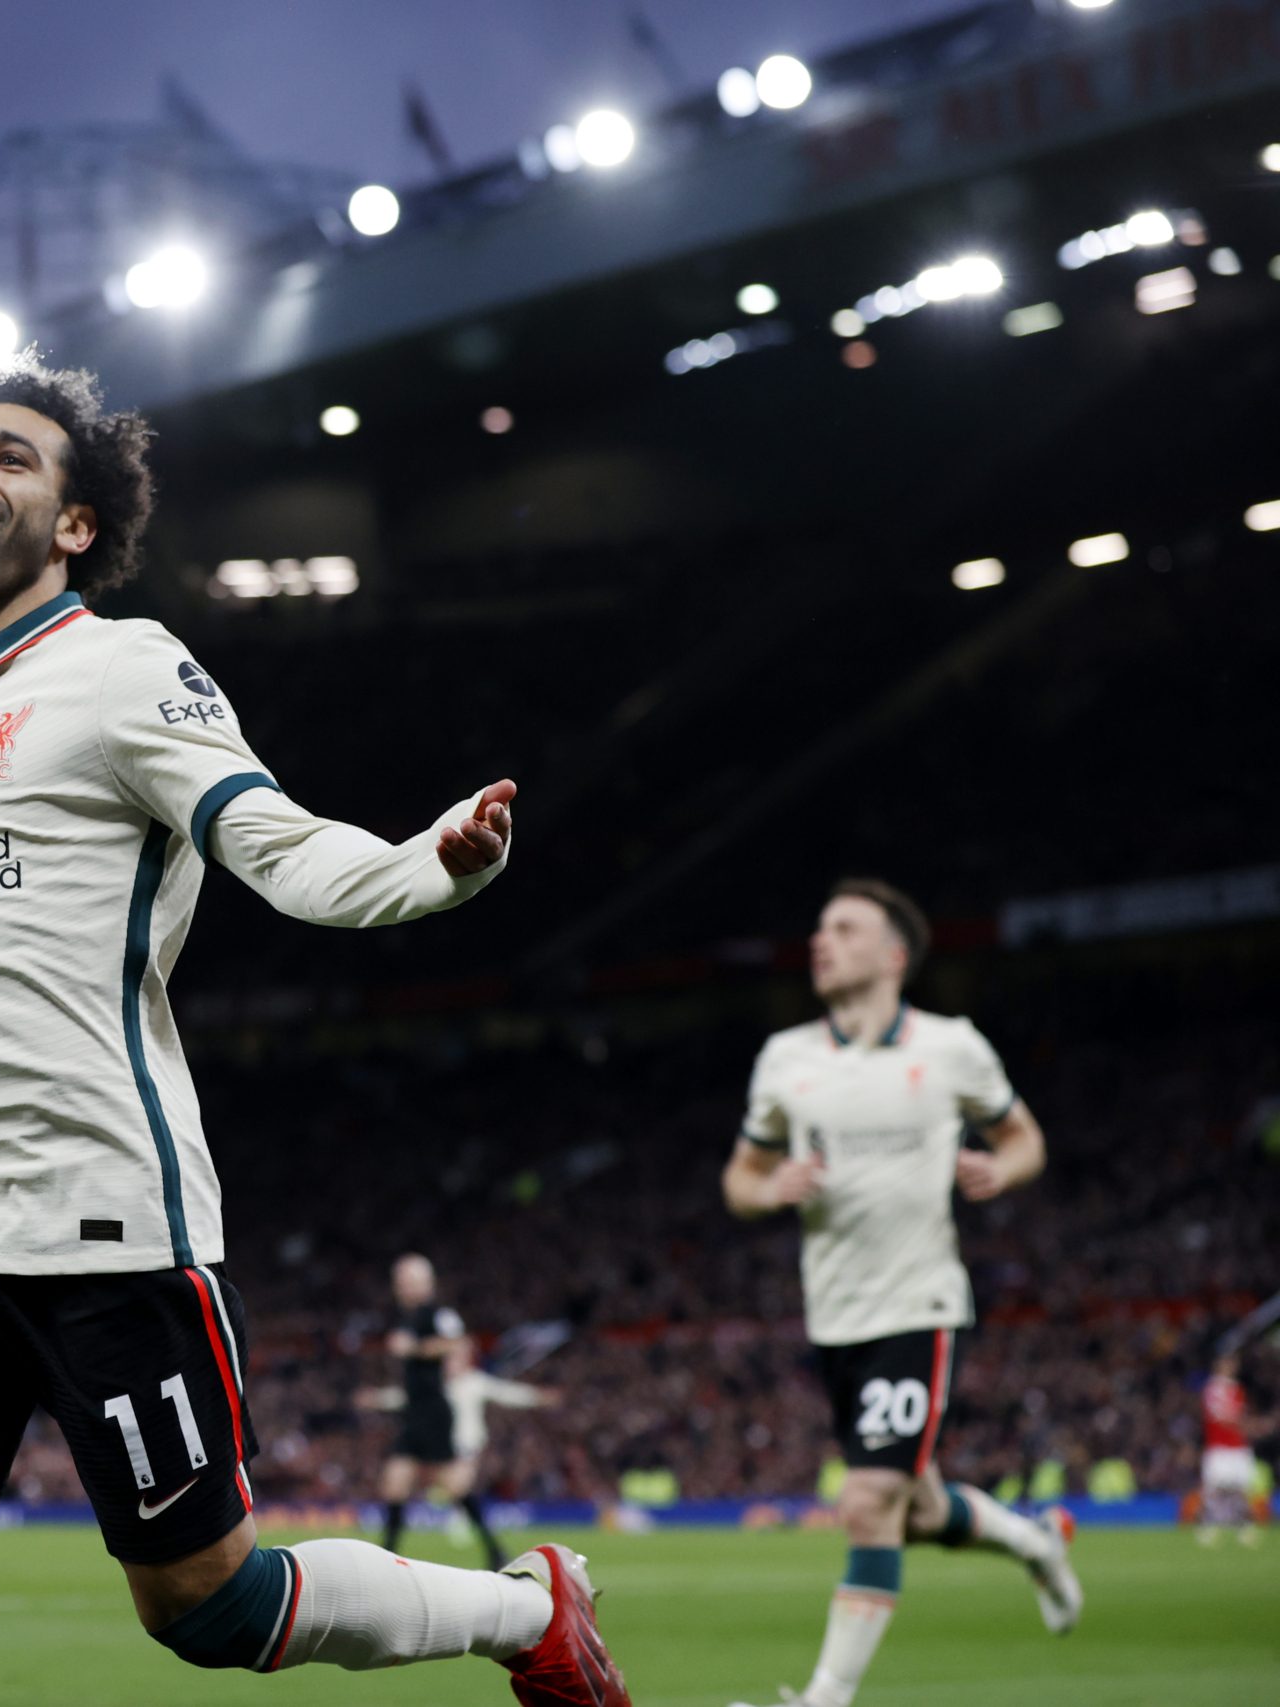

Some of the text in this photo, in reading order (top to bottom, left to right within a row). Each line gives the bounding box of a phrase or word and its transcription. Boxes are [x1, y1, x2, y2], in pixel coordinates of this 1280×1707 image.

[158, 699, 225, 725] Expe
[104, 1372, 209, 1490] 11
[856, 1377, 930, 1437] 20
